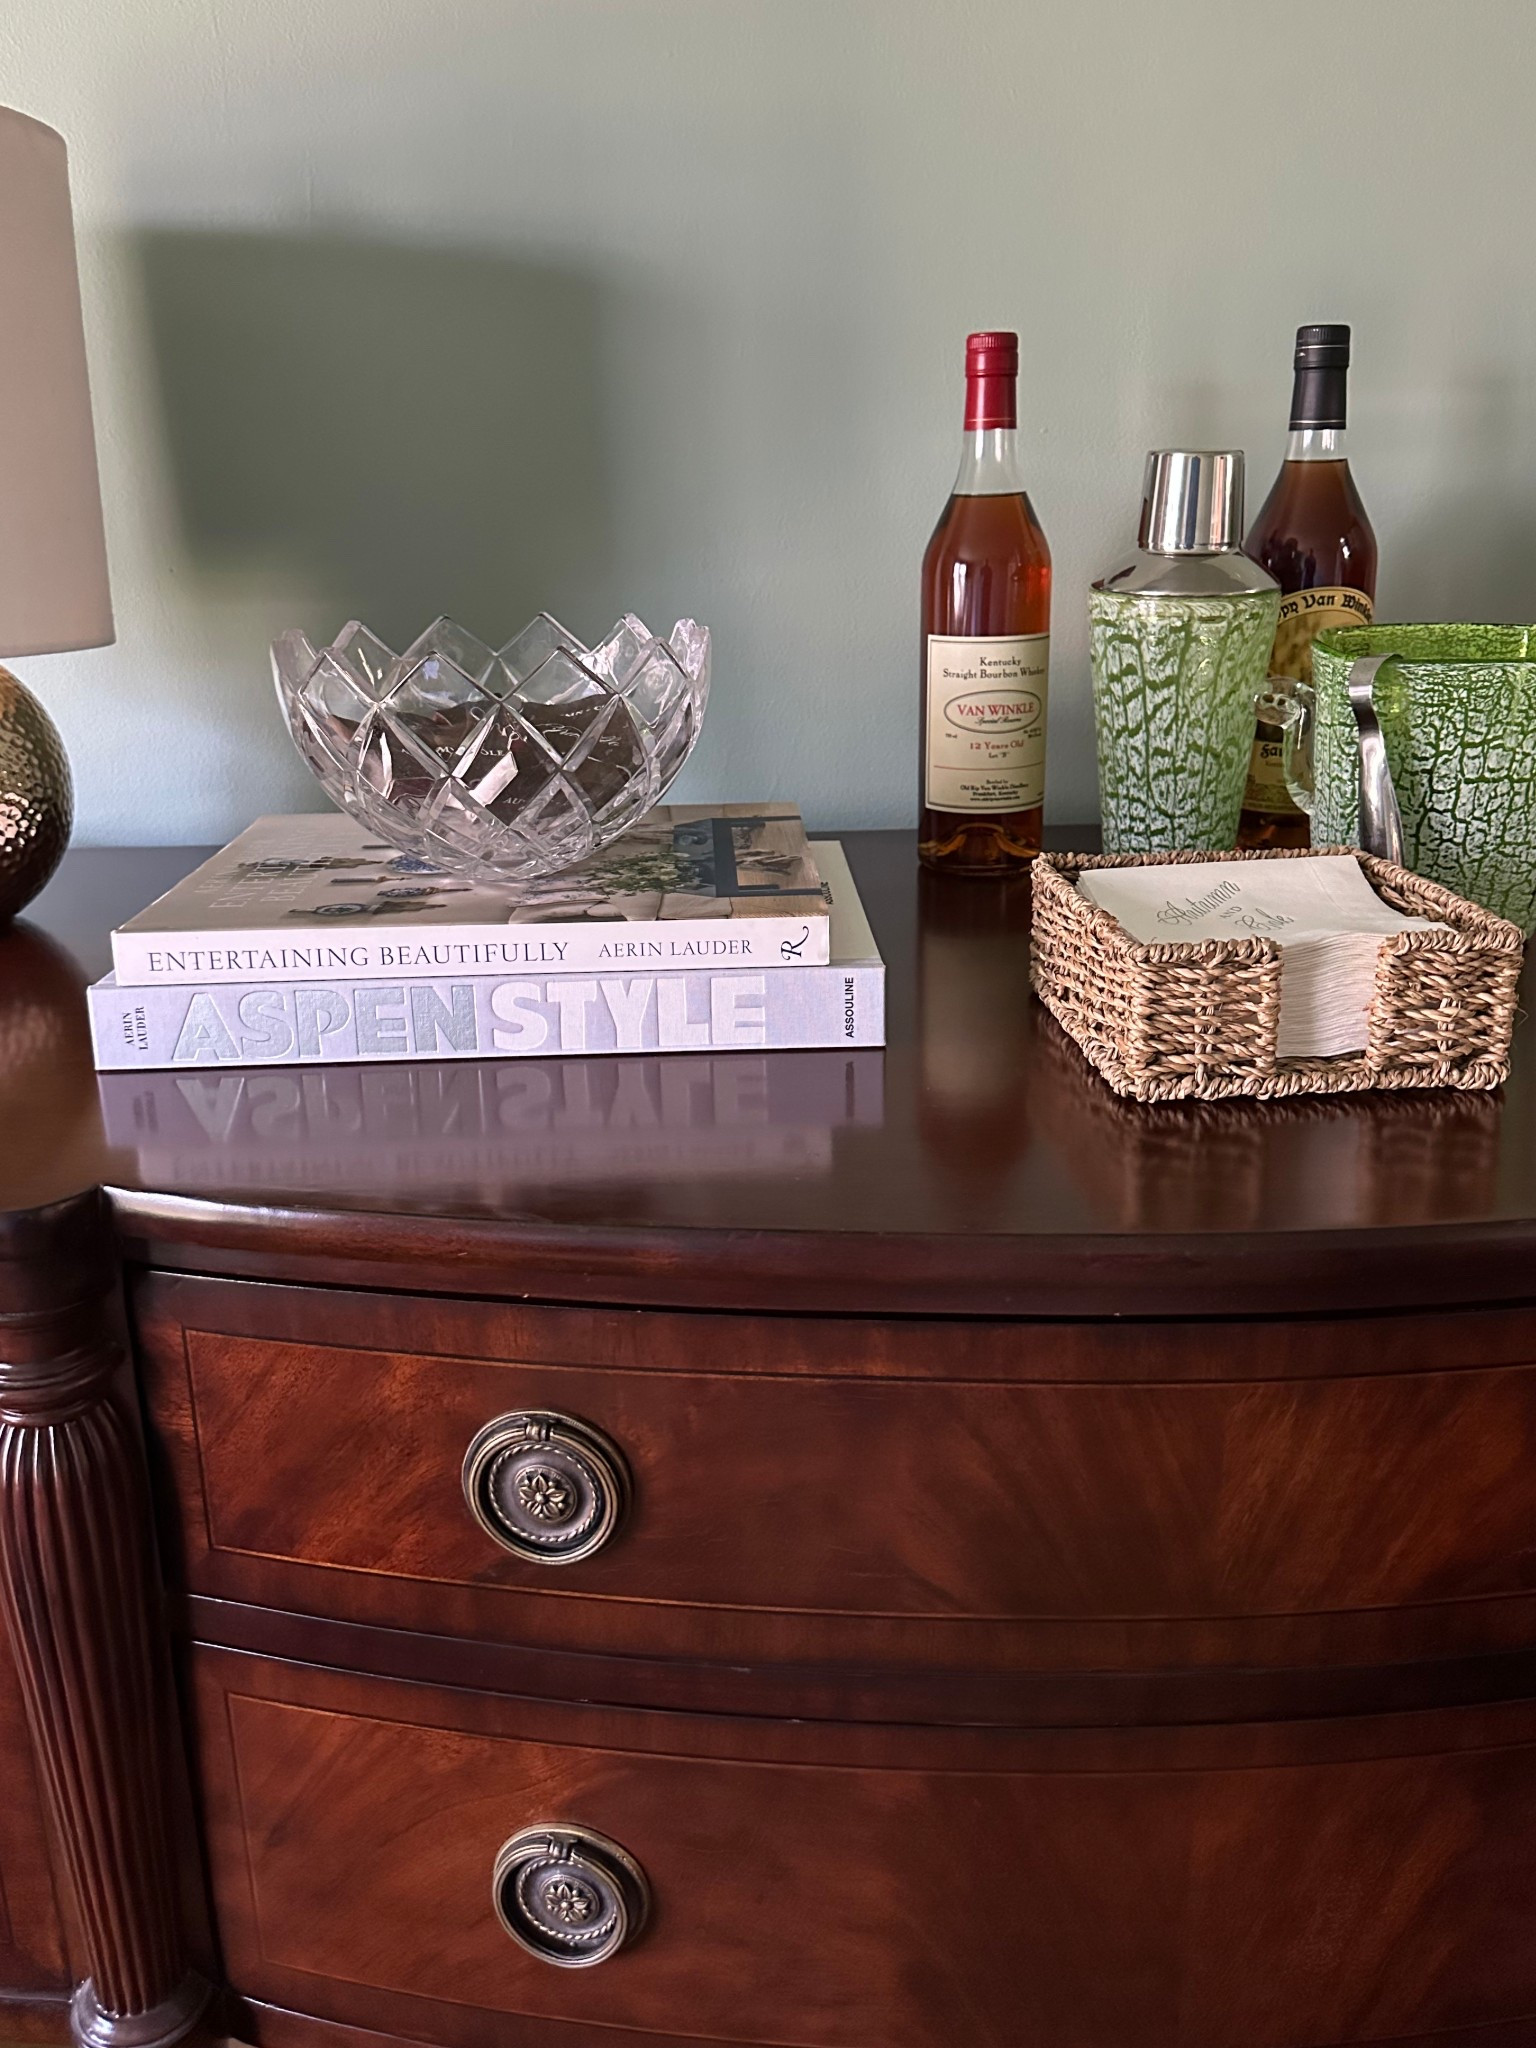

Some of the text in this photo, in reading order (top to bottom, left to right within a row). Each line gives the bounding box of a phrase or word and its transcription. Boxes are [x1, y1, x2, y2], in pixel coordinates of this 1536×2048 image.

[1301, 594, 1336, 609] Van
[943, 668, 977, 680] Straight
[979, 669, 1018, 679] Bourbon
[979, 656, 1021, 667] Kentucky
[957, 702, 1035, 716] VAN WINKLE
[969, 740, 1025, 750] 12 Years Old
[1156, 880, 1241, 926] Autumn
[148, 939, 753, 972] ENTERTAINING BEAUTIFULLY AERIN LAUDER
[172, 976, 766, 1062] ASPEN STYLE
[844, 977, 855, 1038] ASSOULINE
[123, 1011, 136, 1046] AERIN
[135, 1006, 149, 1050] LAUDER
